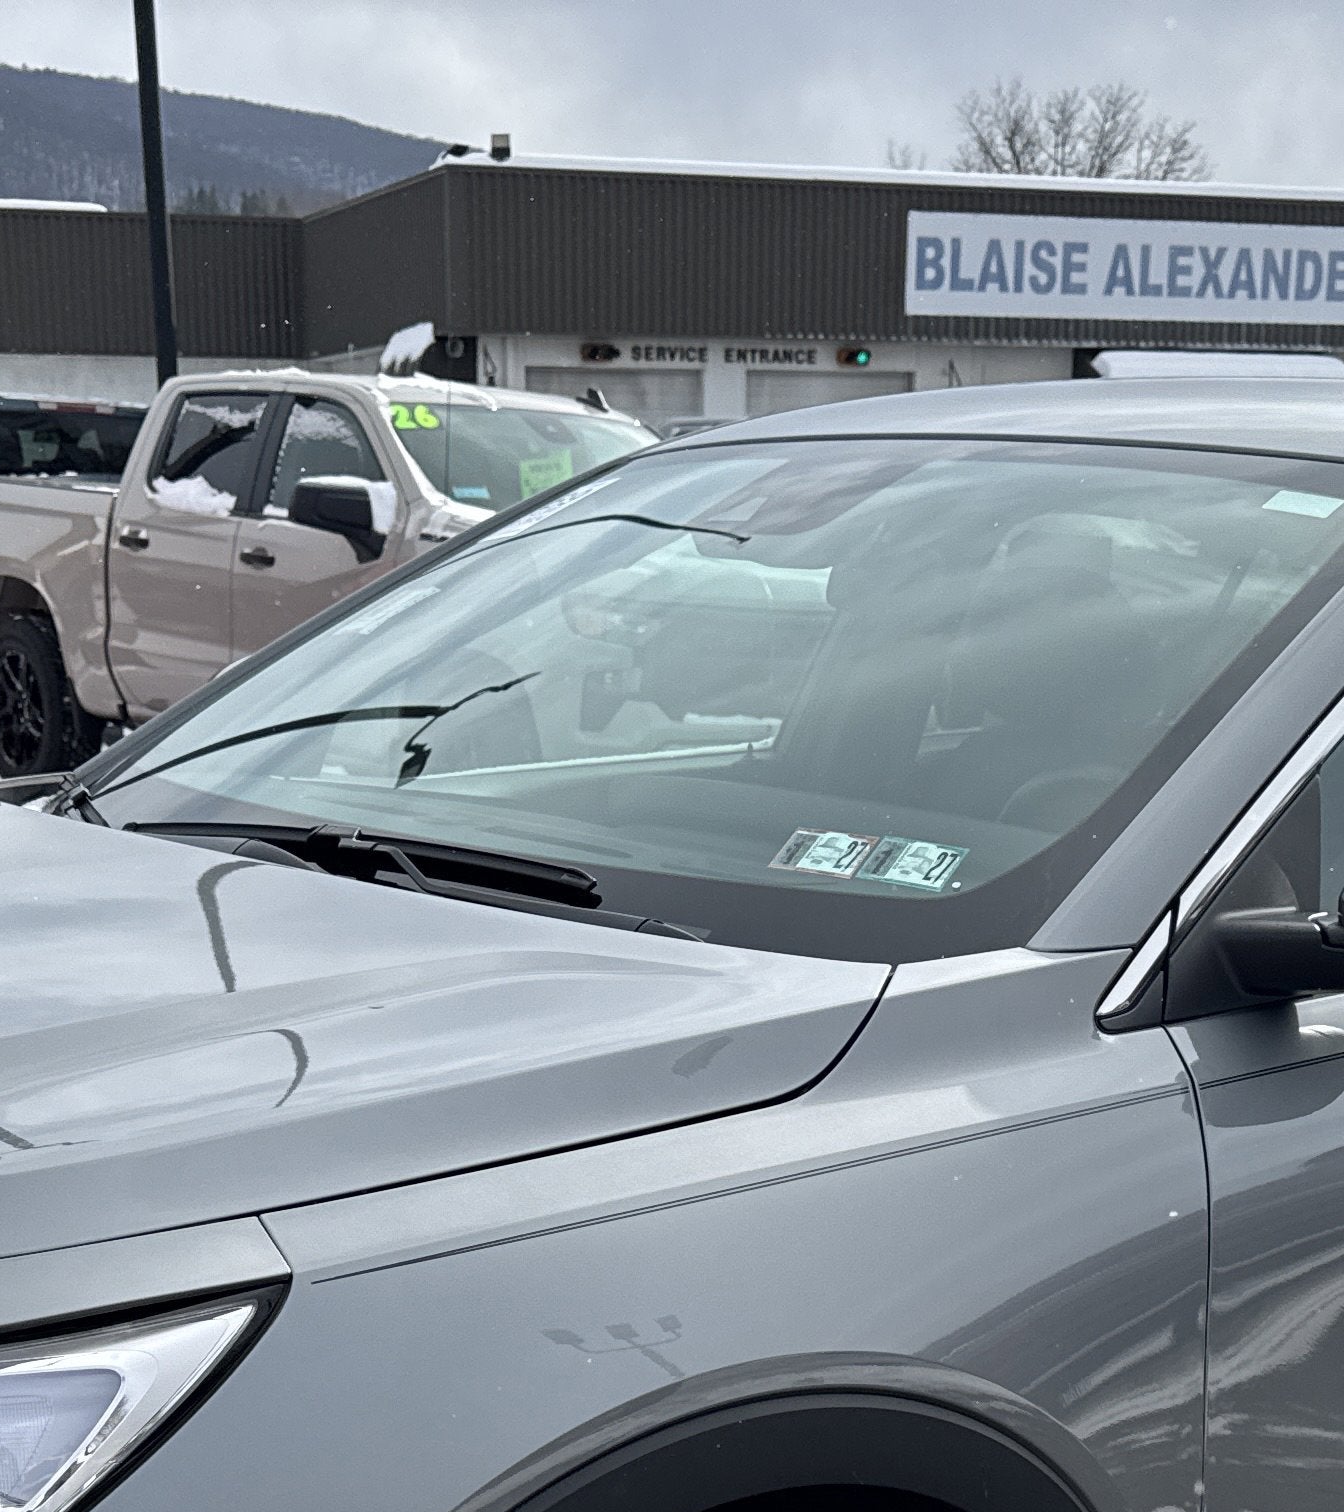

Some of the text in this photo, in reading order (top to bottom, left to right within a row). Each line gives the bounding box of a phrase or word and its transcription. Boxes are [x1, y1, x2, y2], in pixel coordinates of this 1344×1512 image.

[914, 235, 1090, 296] BLAISE
[630, 345, 818, 365] SERVICE ENTRANCE
[390, 402, 440, 430] 26
[832, 841, 869, 871] 27
[922, 851, 959, 884] 27
